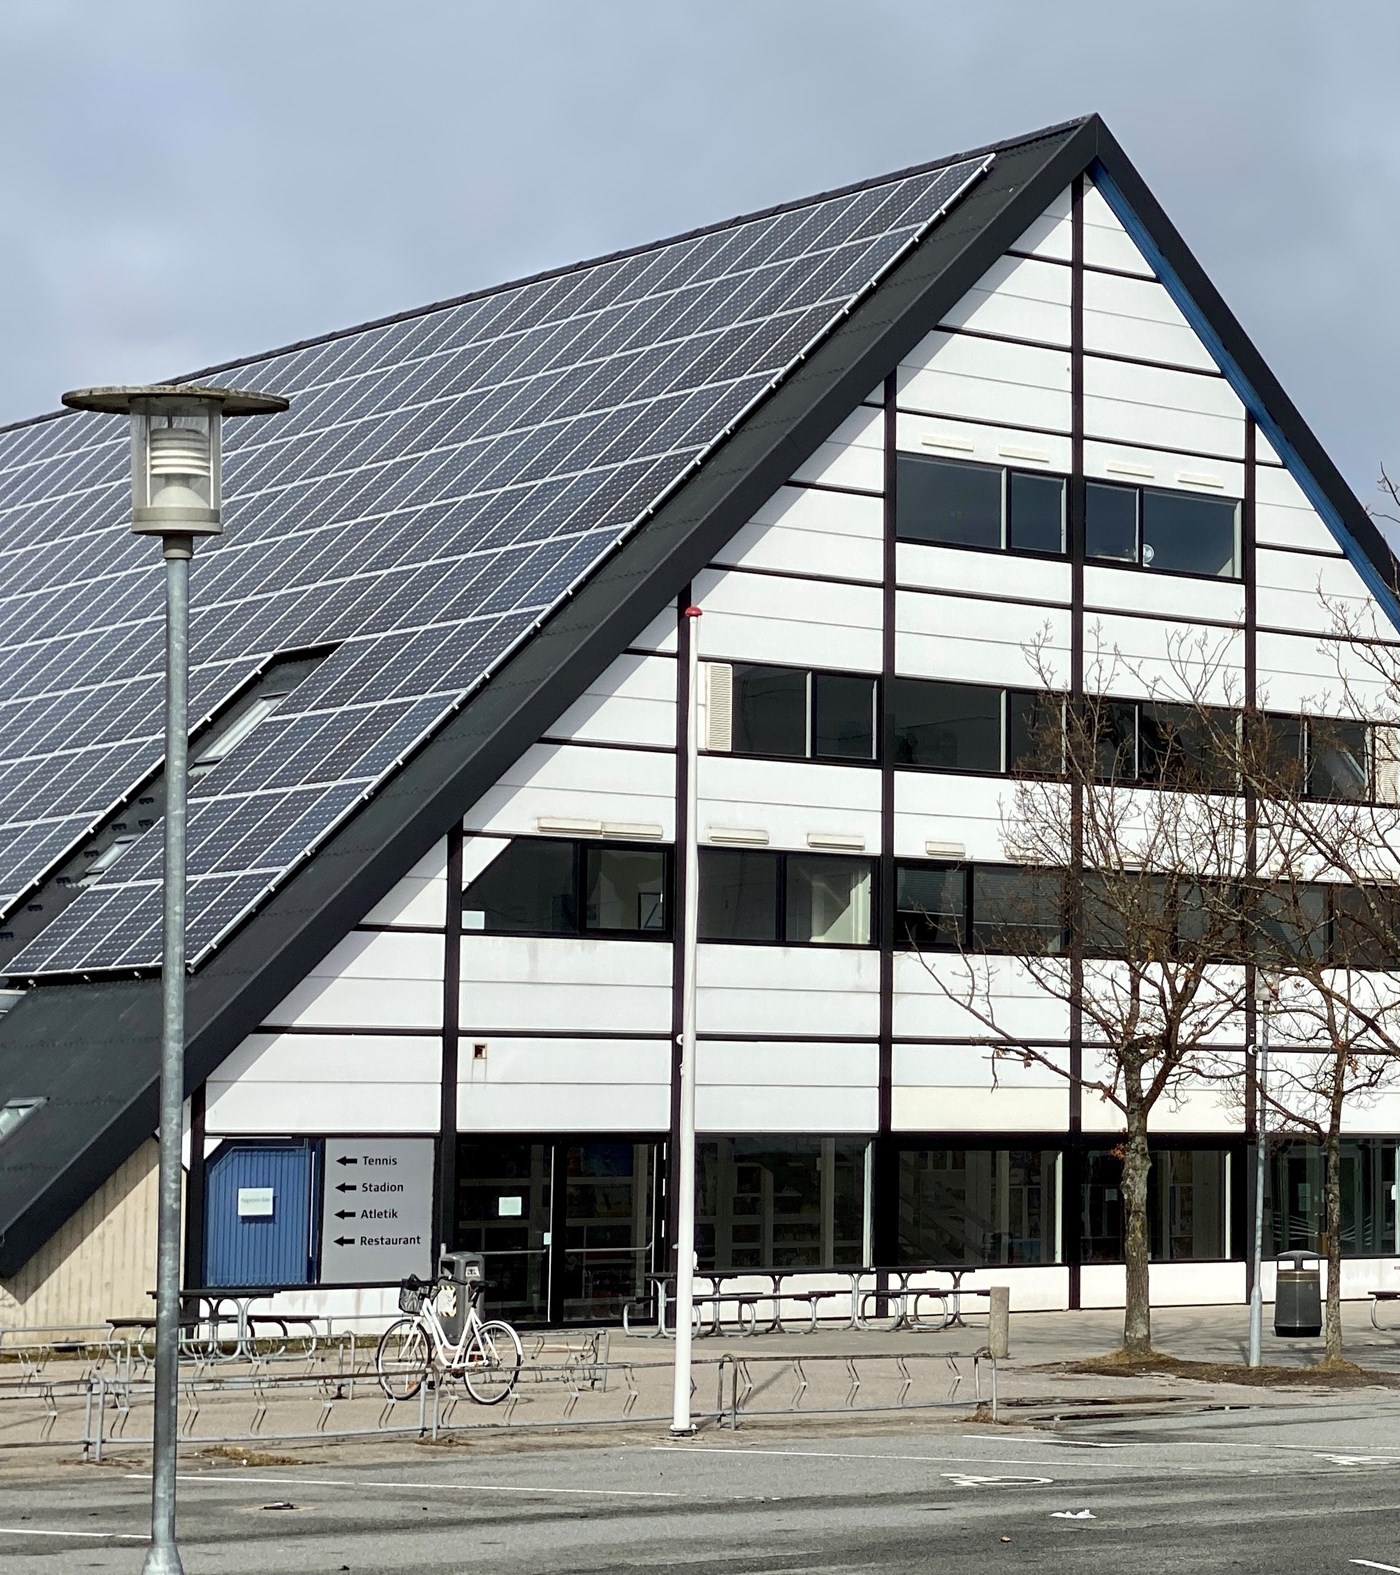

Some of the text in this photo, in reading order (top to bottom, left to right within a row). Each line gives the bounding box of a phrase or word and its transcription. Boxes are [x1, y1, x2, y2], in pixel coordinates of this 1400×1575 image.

[362, 1155, 398, 1166] Tennis
[361, 1181, 404, 1193] Stadion
[360, 1208, 399, 1219] Atletik
[360, 1234, 421, 1246] Restaurant
